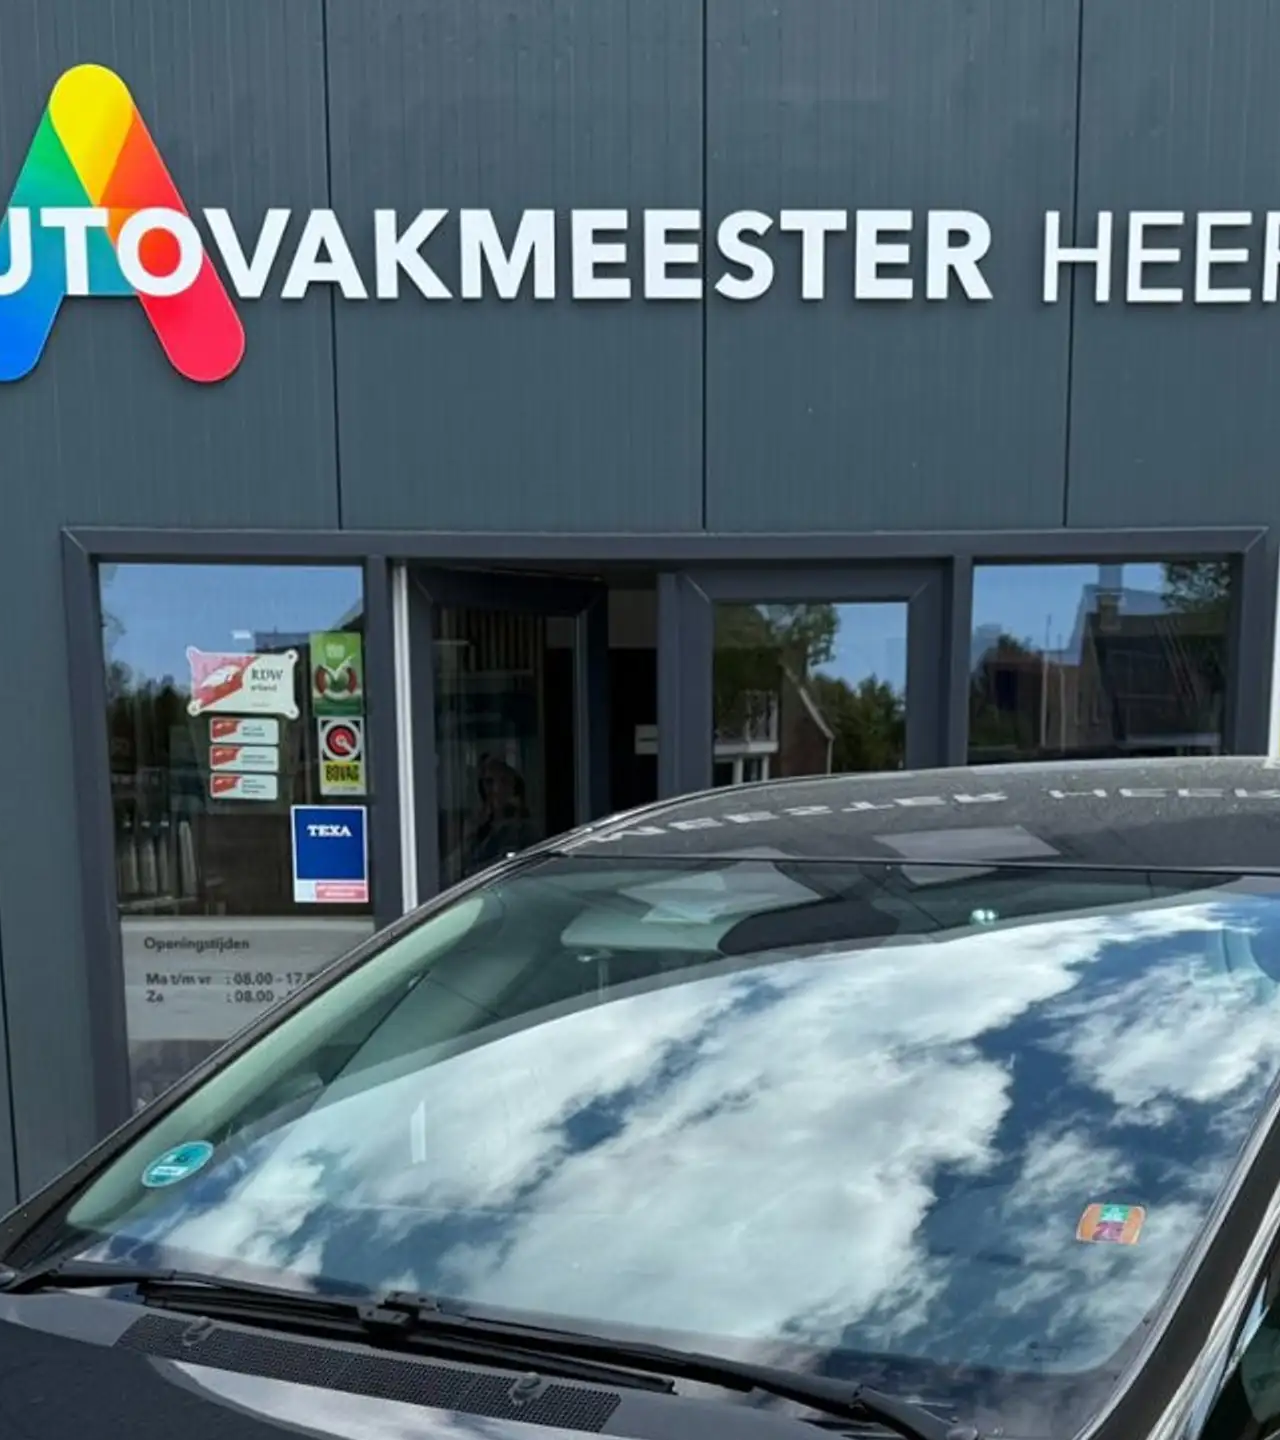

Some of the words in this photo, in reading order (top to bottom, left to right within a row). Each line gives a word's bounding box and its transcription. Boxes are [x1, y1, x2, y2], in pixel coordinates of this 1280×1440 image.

[250, 667, 283, 682] RDW
[325, 763, 360, 782] BOVAG
[306, 824, 352, 837] TEXA
[144, 936, 250, 953] Openingstijden
[145, 973, 167, 986] Ma
[171, 972, 195, 985] t/m
[198, 975, 212, 985] vr
[233, 973, 273, 986] 08.00
[146, 990, 164, 1002] Za
[234, 990, 274, 1003] 08.00
